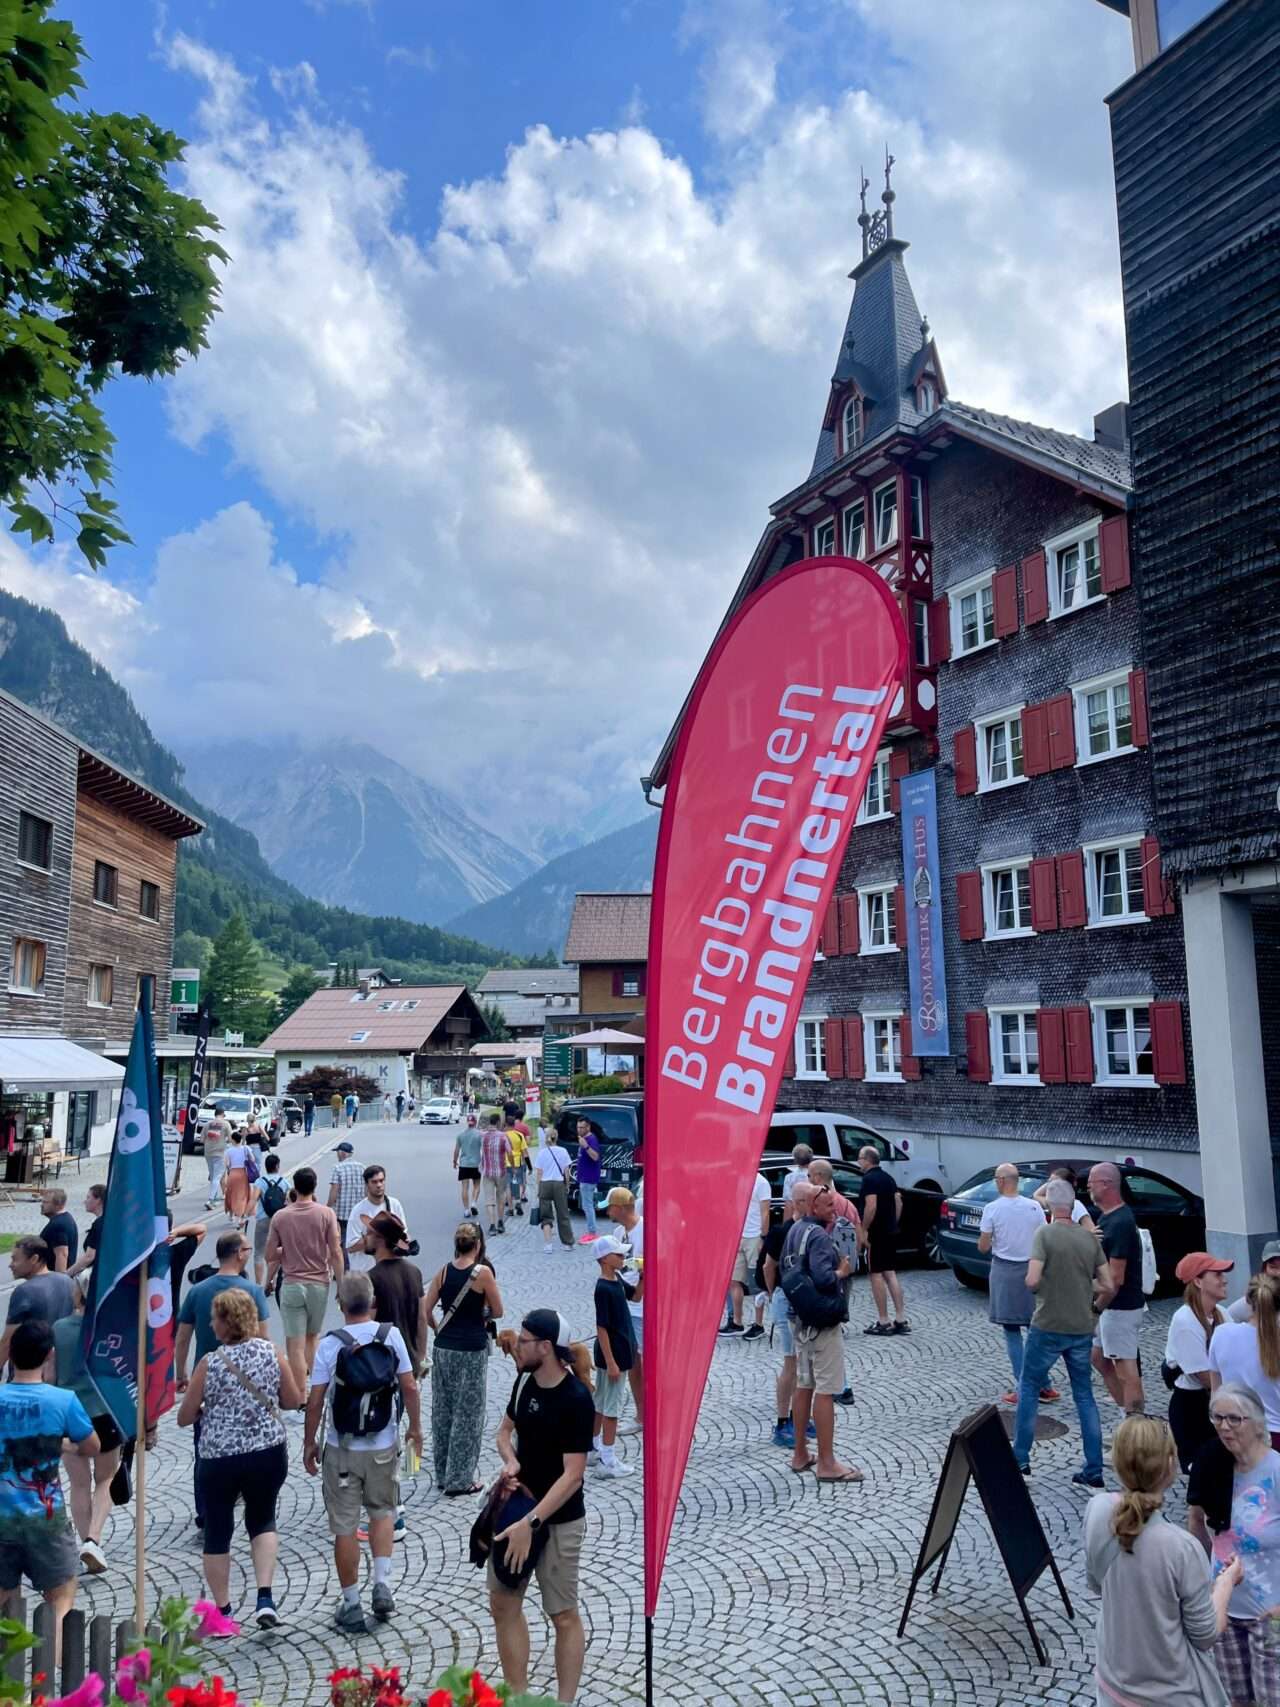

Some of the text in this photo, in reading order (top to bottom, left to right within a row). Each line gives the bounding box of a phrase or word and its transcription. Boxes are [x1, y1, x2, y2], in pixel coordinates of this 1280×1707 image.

[661, 683, 824, 1090] Bergbahnen
[714, 684, 889, 1115] Brandnertal
[914, 818, 927, 859] HUS
[188, 1036, 206, 1125] OPEN
